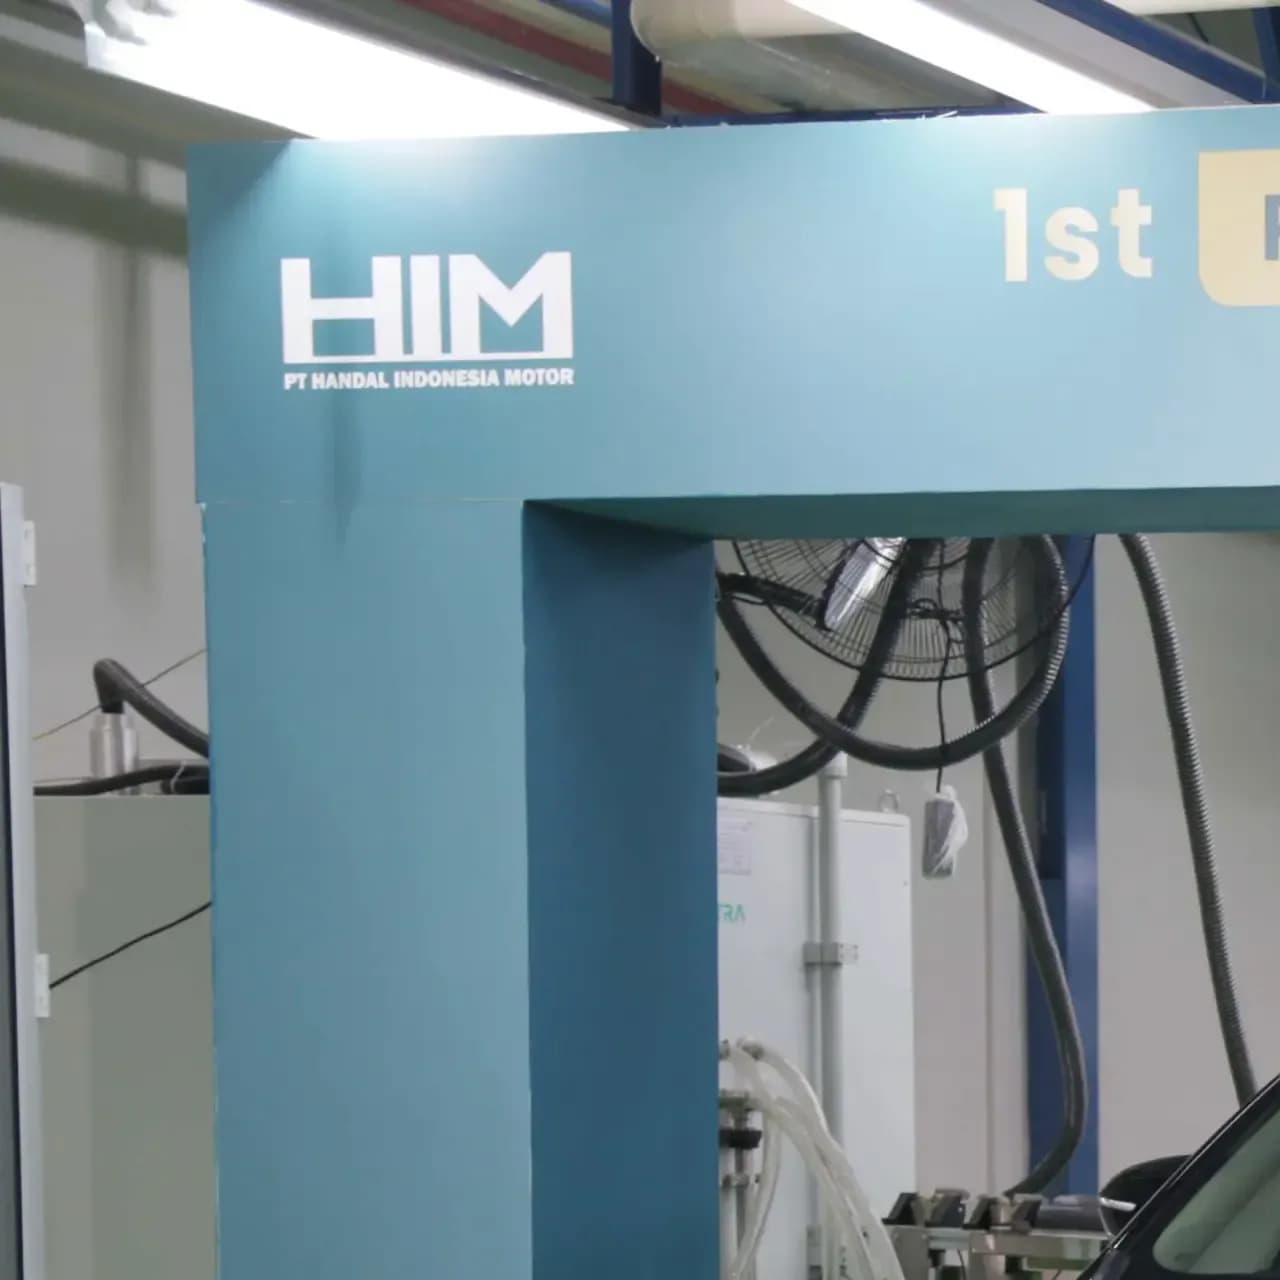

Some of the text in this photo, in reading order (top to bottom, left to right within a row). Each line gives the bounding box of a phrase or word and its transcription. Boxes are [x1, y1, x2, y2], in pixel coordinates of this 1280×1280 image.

[994, 188, 1152, 281] 1st
[280, 251, 573, 364] HIM
[284, 368, 575, 390] PT HANDAL INDONESIA MOTOR
